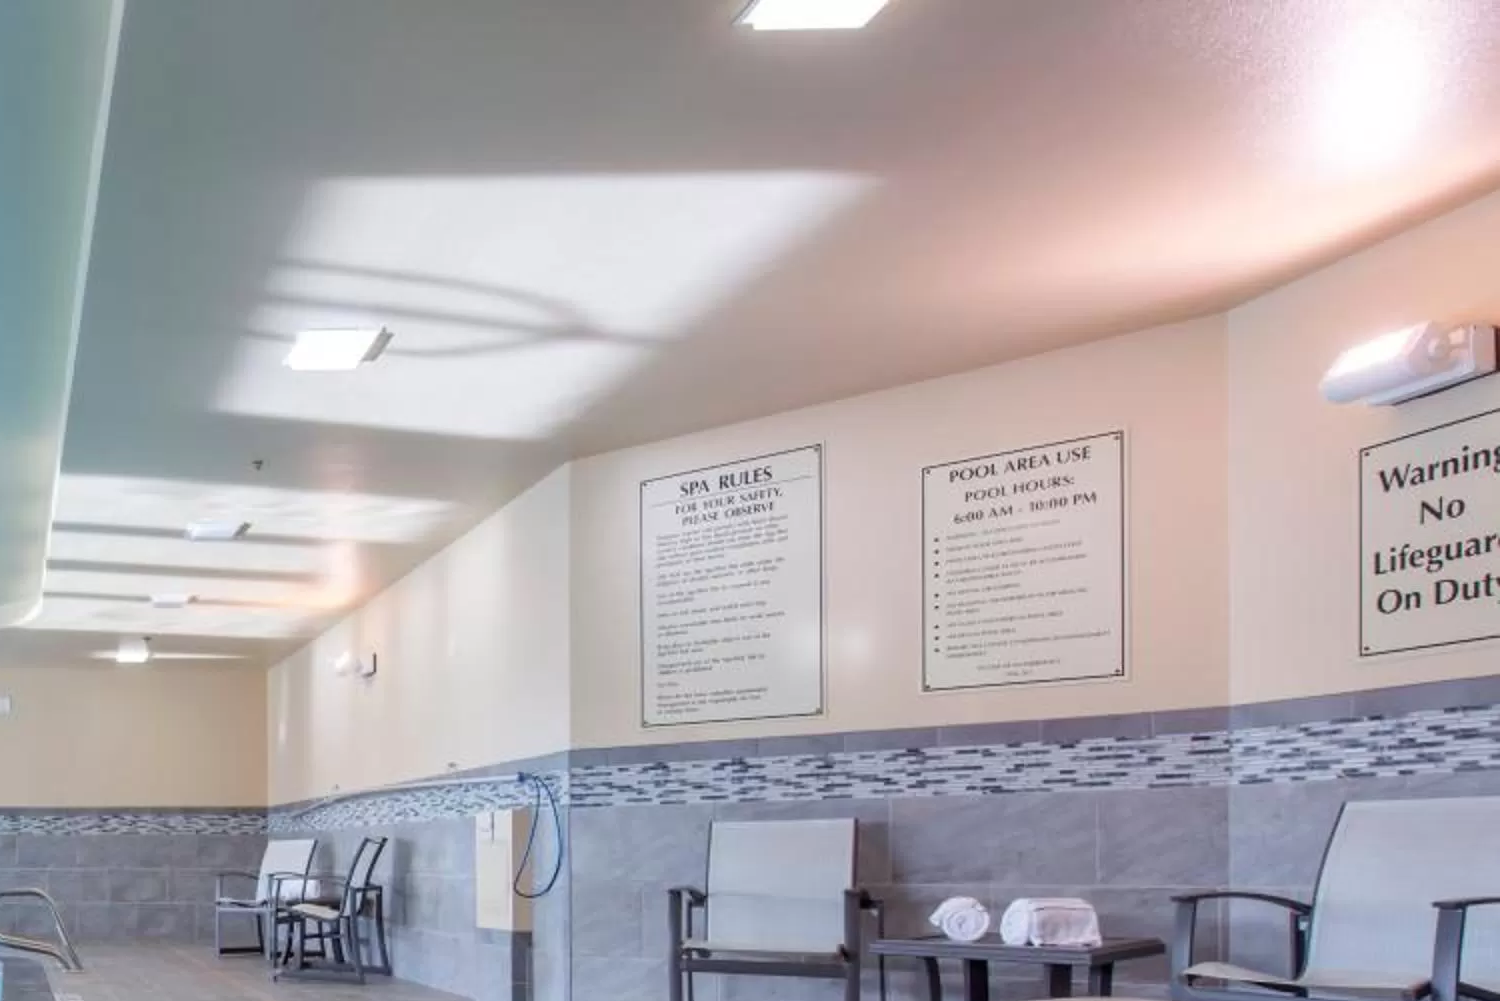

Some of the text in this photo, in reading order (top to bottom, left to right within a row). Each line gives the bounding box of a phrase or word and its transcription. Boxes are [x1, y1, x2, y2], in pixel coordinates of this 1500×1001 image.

[948, 445, 1092, 483] POOL AREA USE
[679, 466, 773, 498] SPA RULES
[964, 476, 1075, 503] POOL HOURS:
[675, 502, 698, 515] FOR
[703, 495, 735, 511] YOUR
[682, 502, 775, 526] PLEASE OBSERVE
[953, 510, 985, 525] 6:00
[988, 505, 1014, 519] AM
[1029, 497, 1069, 512] 10:00
[1072, 491, 1098, 506] PM
[1419, 495, 1466, 526] No
[1373, 531, 1500, 576] Lifeguar
[1376, 588, 1421, 615] On
